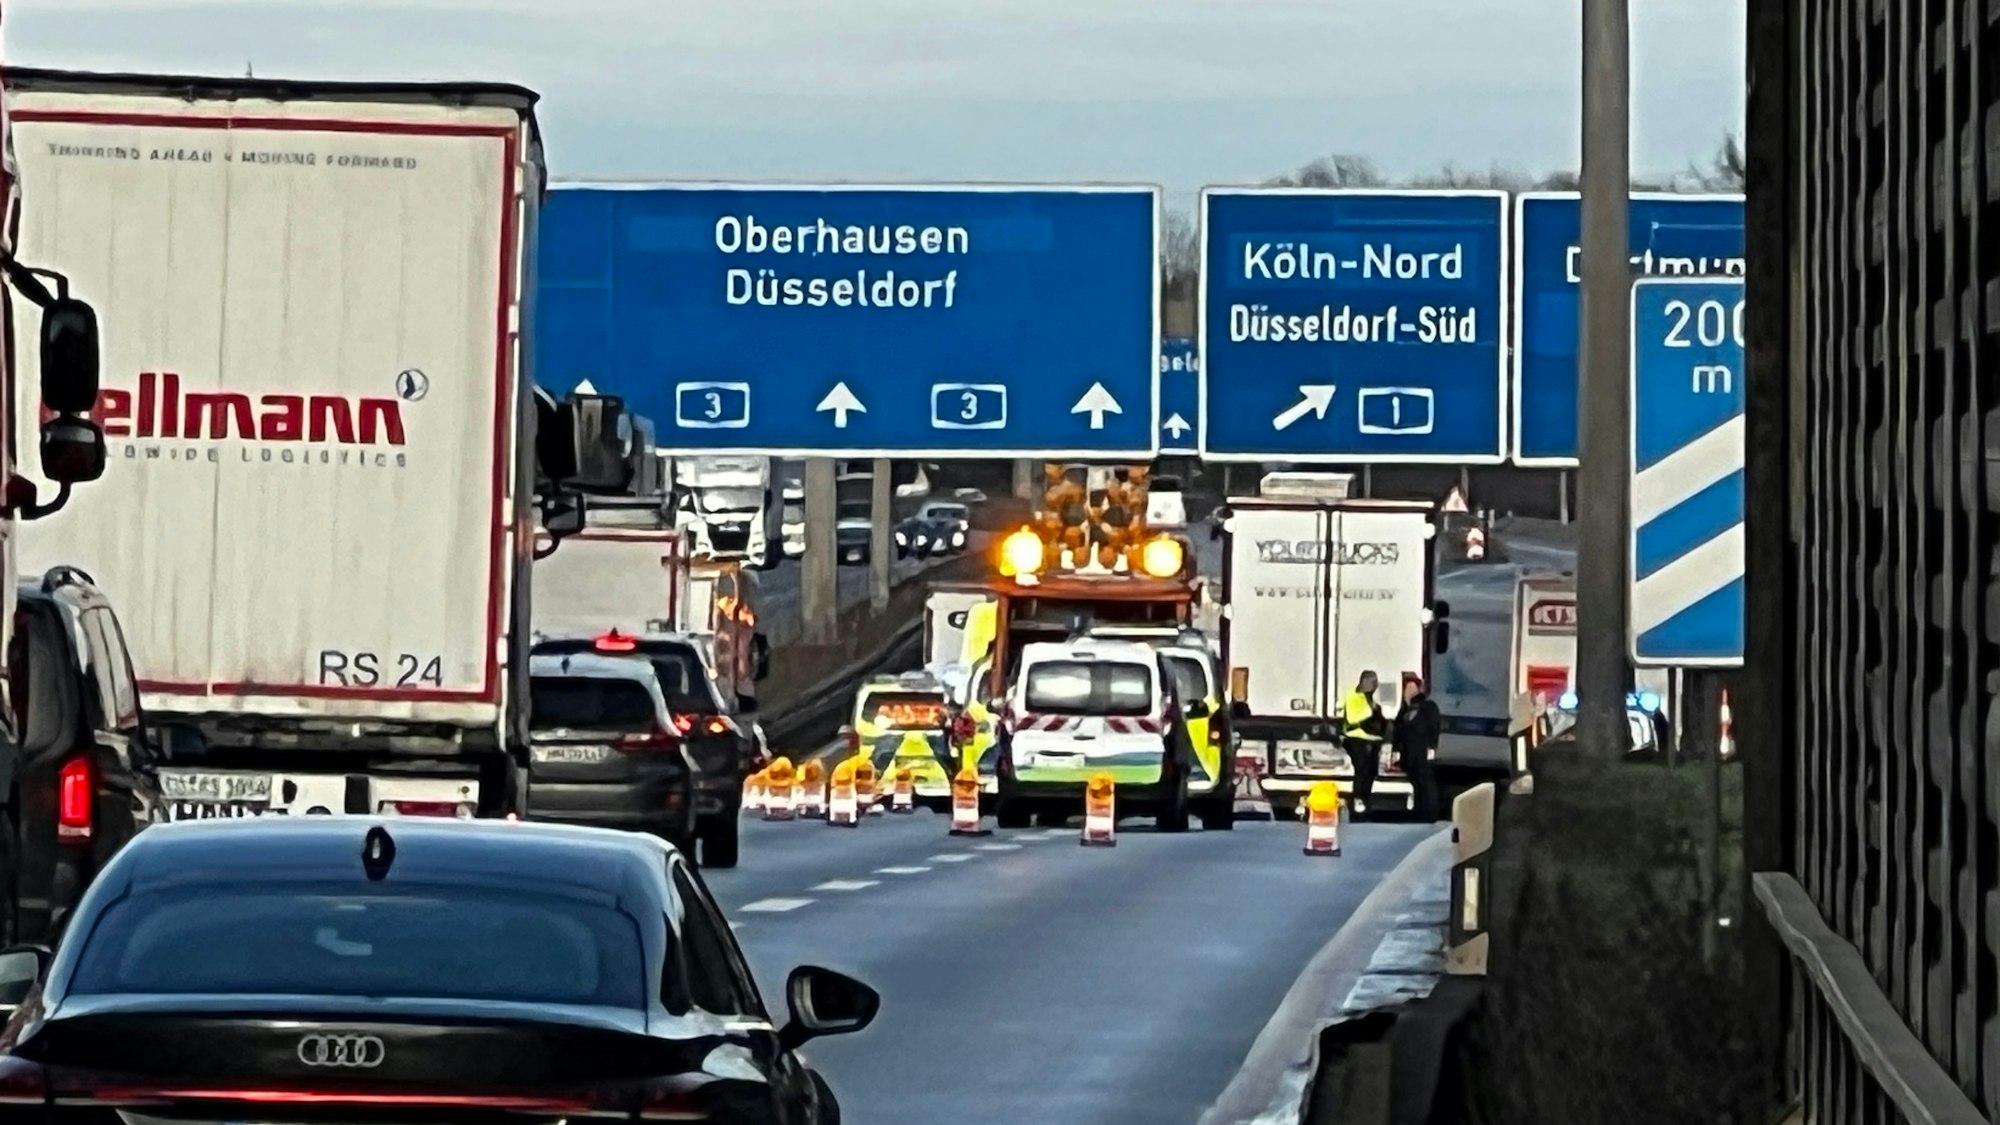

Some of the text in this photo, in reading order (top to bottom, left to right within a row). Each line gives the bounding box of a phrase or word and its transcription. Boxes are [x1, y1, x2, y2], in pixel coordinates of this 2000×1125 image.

[715, 215, 969, 254] Oberhausen
[1244, 242, 1463, 280] Köln-Nord
[726, 268, 958, 308] Düsseldorf
[1230, 304, 1477, 344] Düsseldorf-Süd
[1692, 364, 1732, 394] m
[91, 372, 406, 446] ellmann
[704, 392, 721, 419] 3
[960, 392, 977, 420] 3
[320, 650, 442, 688] RS 24
